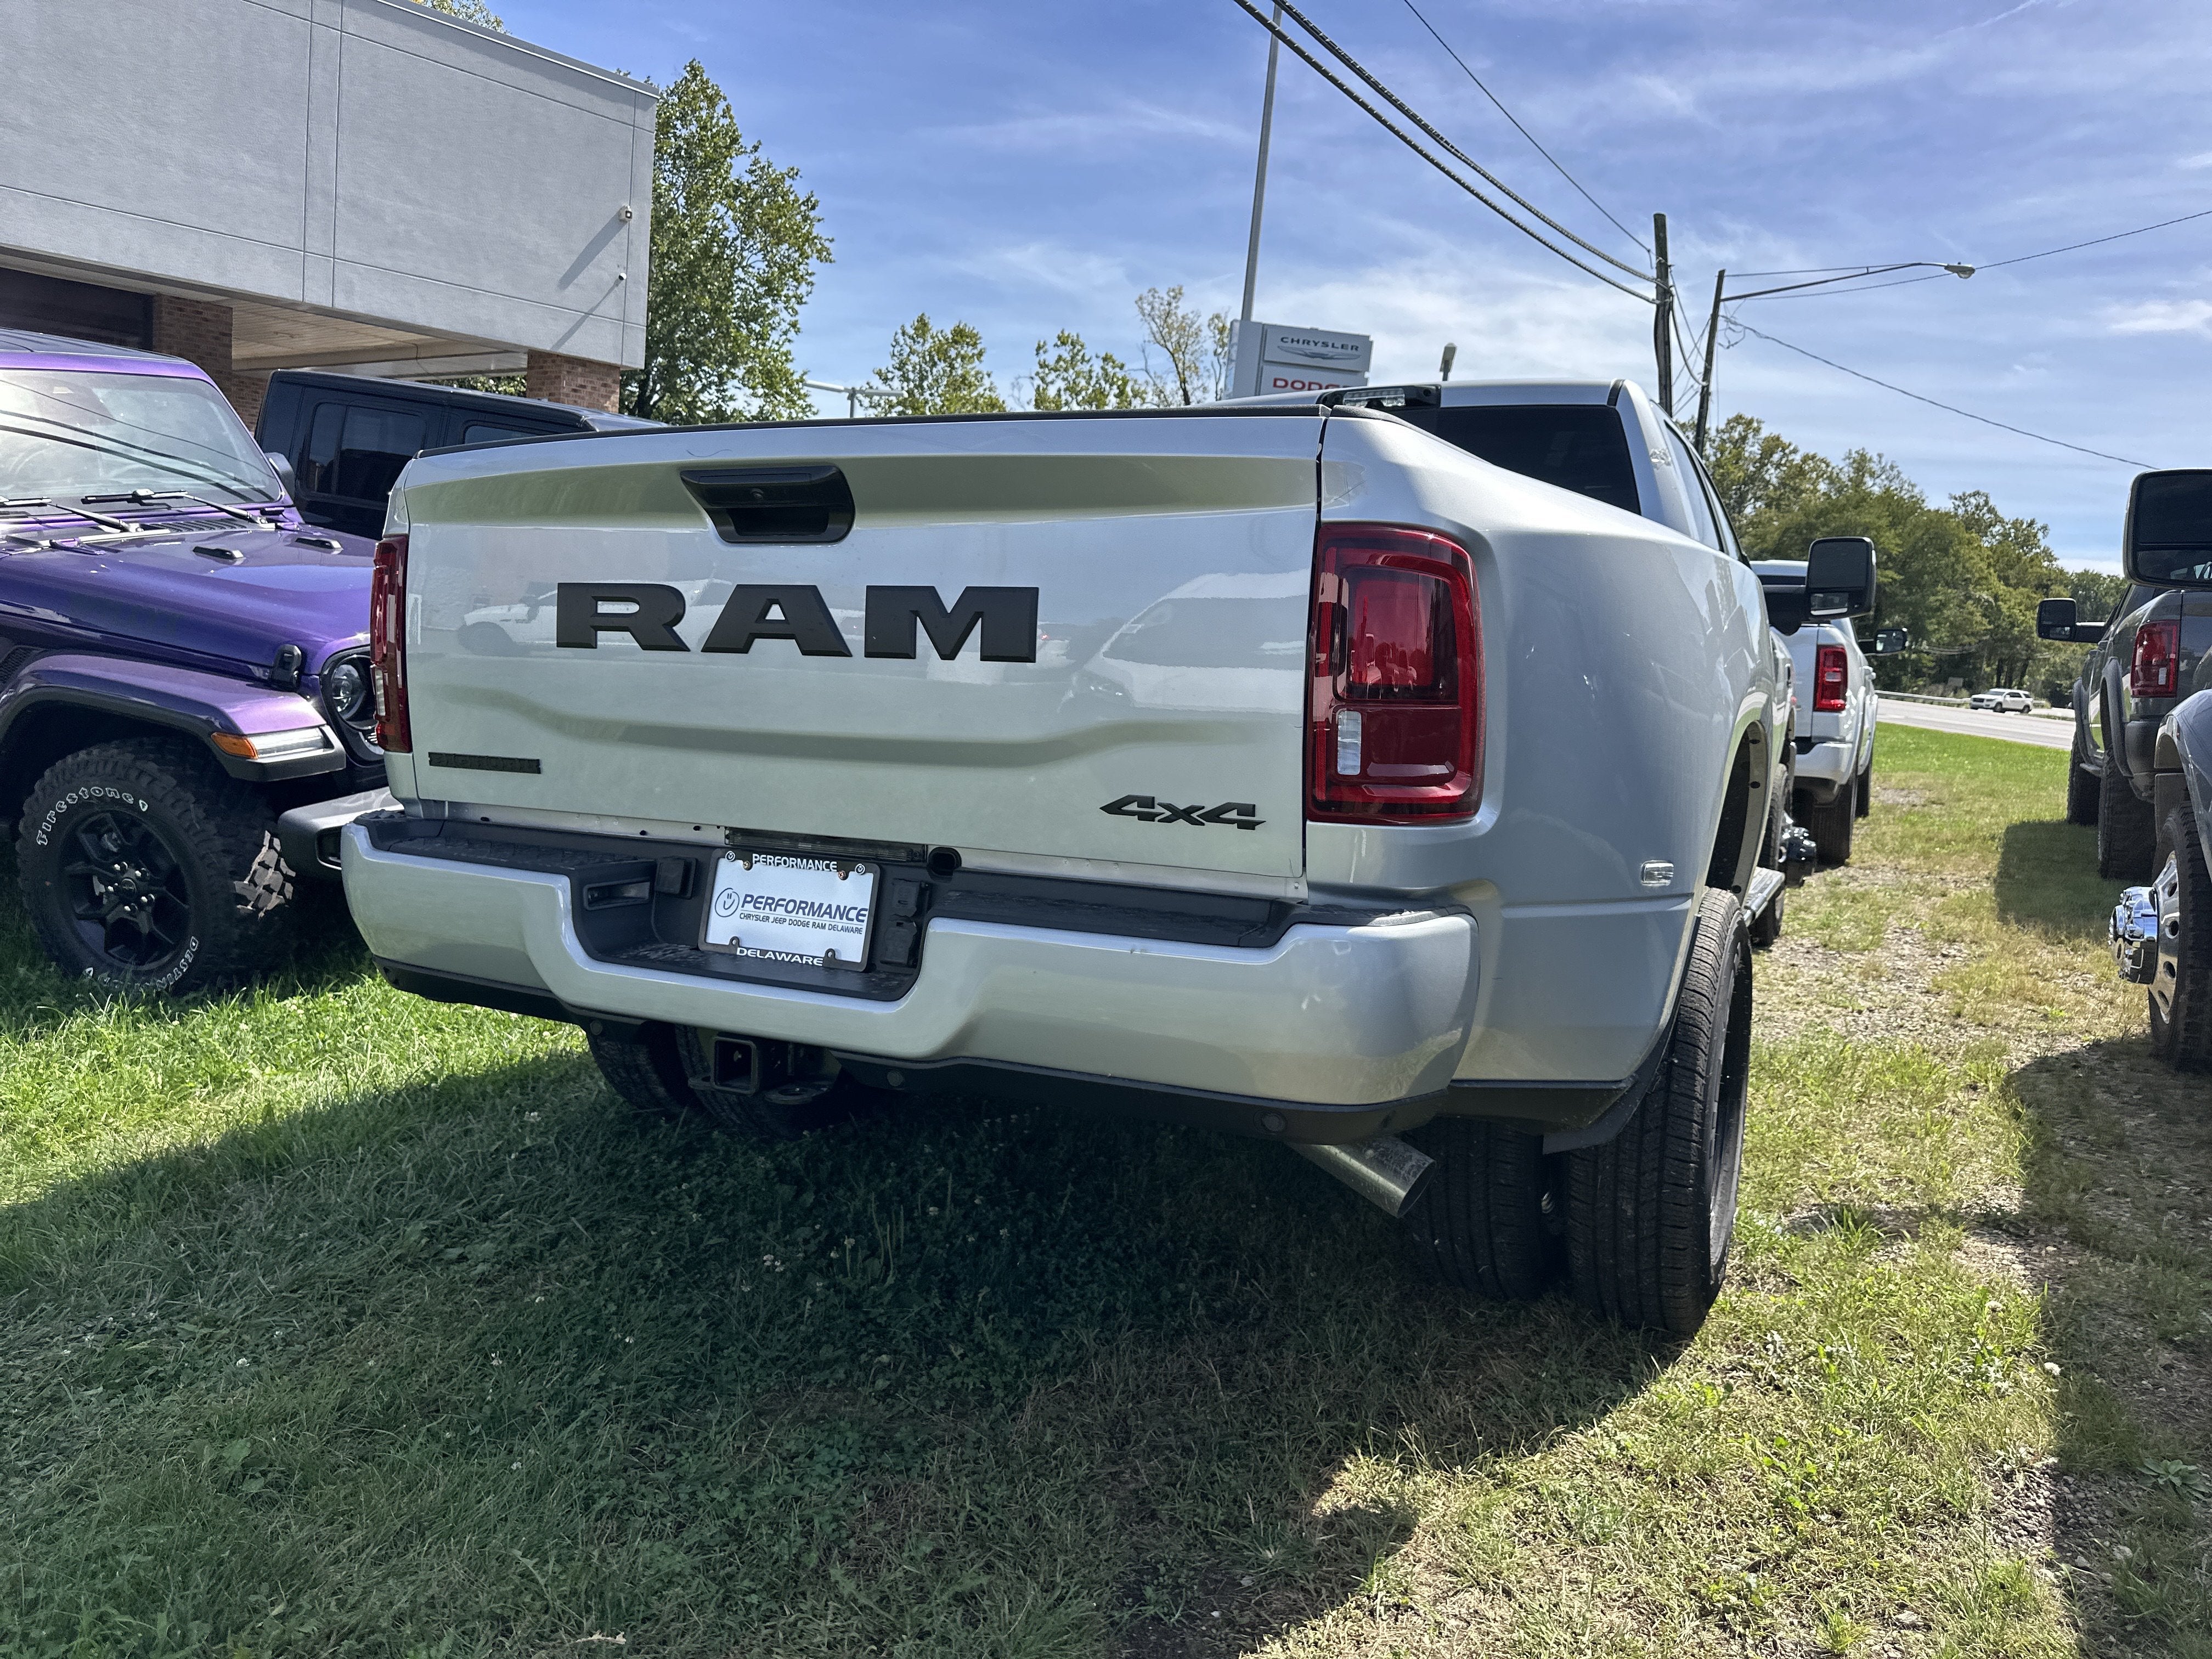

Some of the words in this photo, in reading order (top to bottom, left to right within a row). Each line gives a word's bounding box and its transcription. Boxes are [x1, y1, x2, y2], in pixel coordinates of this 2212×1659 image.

[1280, 336, 1361, 352] CHRYSLER
[1273, 377, 1350, 391] DOD
[556, 582, 1040, 663] RAM
[752, 853, 838, 872] PERFORMANCE
[741, 894, 868, 923] PERFORMANCE
[740, 912, 770, 923] CHRYSLER
[788, 919, 810, 928] DODGE
[828, 923, 864, 935] DELAWARE
[736, 947, 824, 966] DELAWARE
